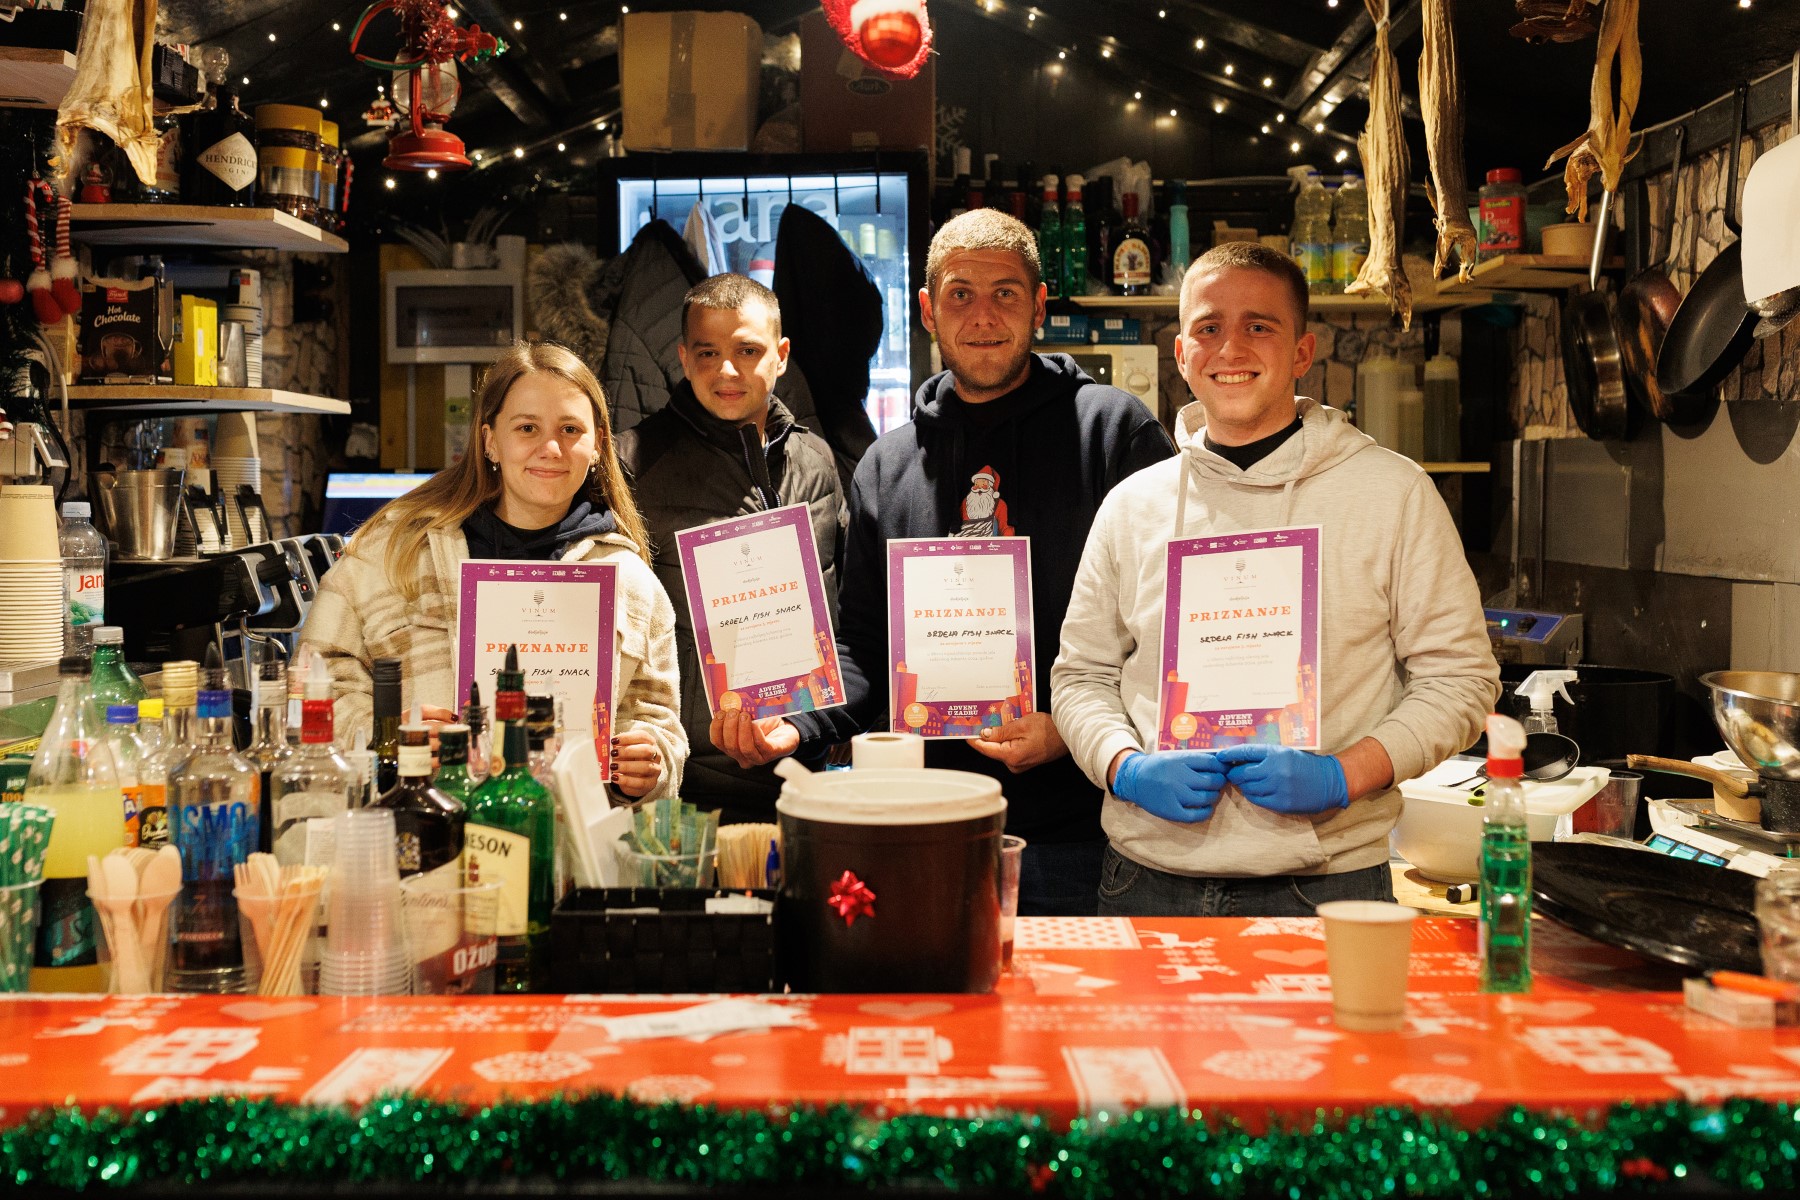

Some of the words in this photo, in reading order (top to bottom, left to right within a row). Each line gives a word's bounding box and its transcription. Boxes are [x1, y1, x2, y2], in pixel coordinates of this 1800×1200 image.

[703, 191, 840, 243] ana
[107, 305, 122, 316] Hot
[93, 311, 141, 328] Chocolate
[711, 580, 799, 608] PRIZNANJE
[719, 616, 749, 628] SRDELA
[752, 611, 771, 621] FISH
[775, 604, 802, 615] SNACK
[913, 607, 1007, 619] PRIZNANJE
[1188, 605, 1292, 623] PRIZNANJE
[926, 630, 959, 638] SRDELA
[961, 630, 982, 638] FISH
[1199, 634, 1232, 644] SRDELA
[1236, 632, 1258, 640] FISH
[1262, 630, 1294, 638] SNACK
[485, 643, 589, 653] PRZNANJE
[531, 668, 553, 677] FISH
[558, 668, 590, 677] SNACK
[758, 682, 786, 695] ADVENT
[764, 687, 788, 697] ZADRU
[1219, 713, 1253, 721] ADVENT
